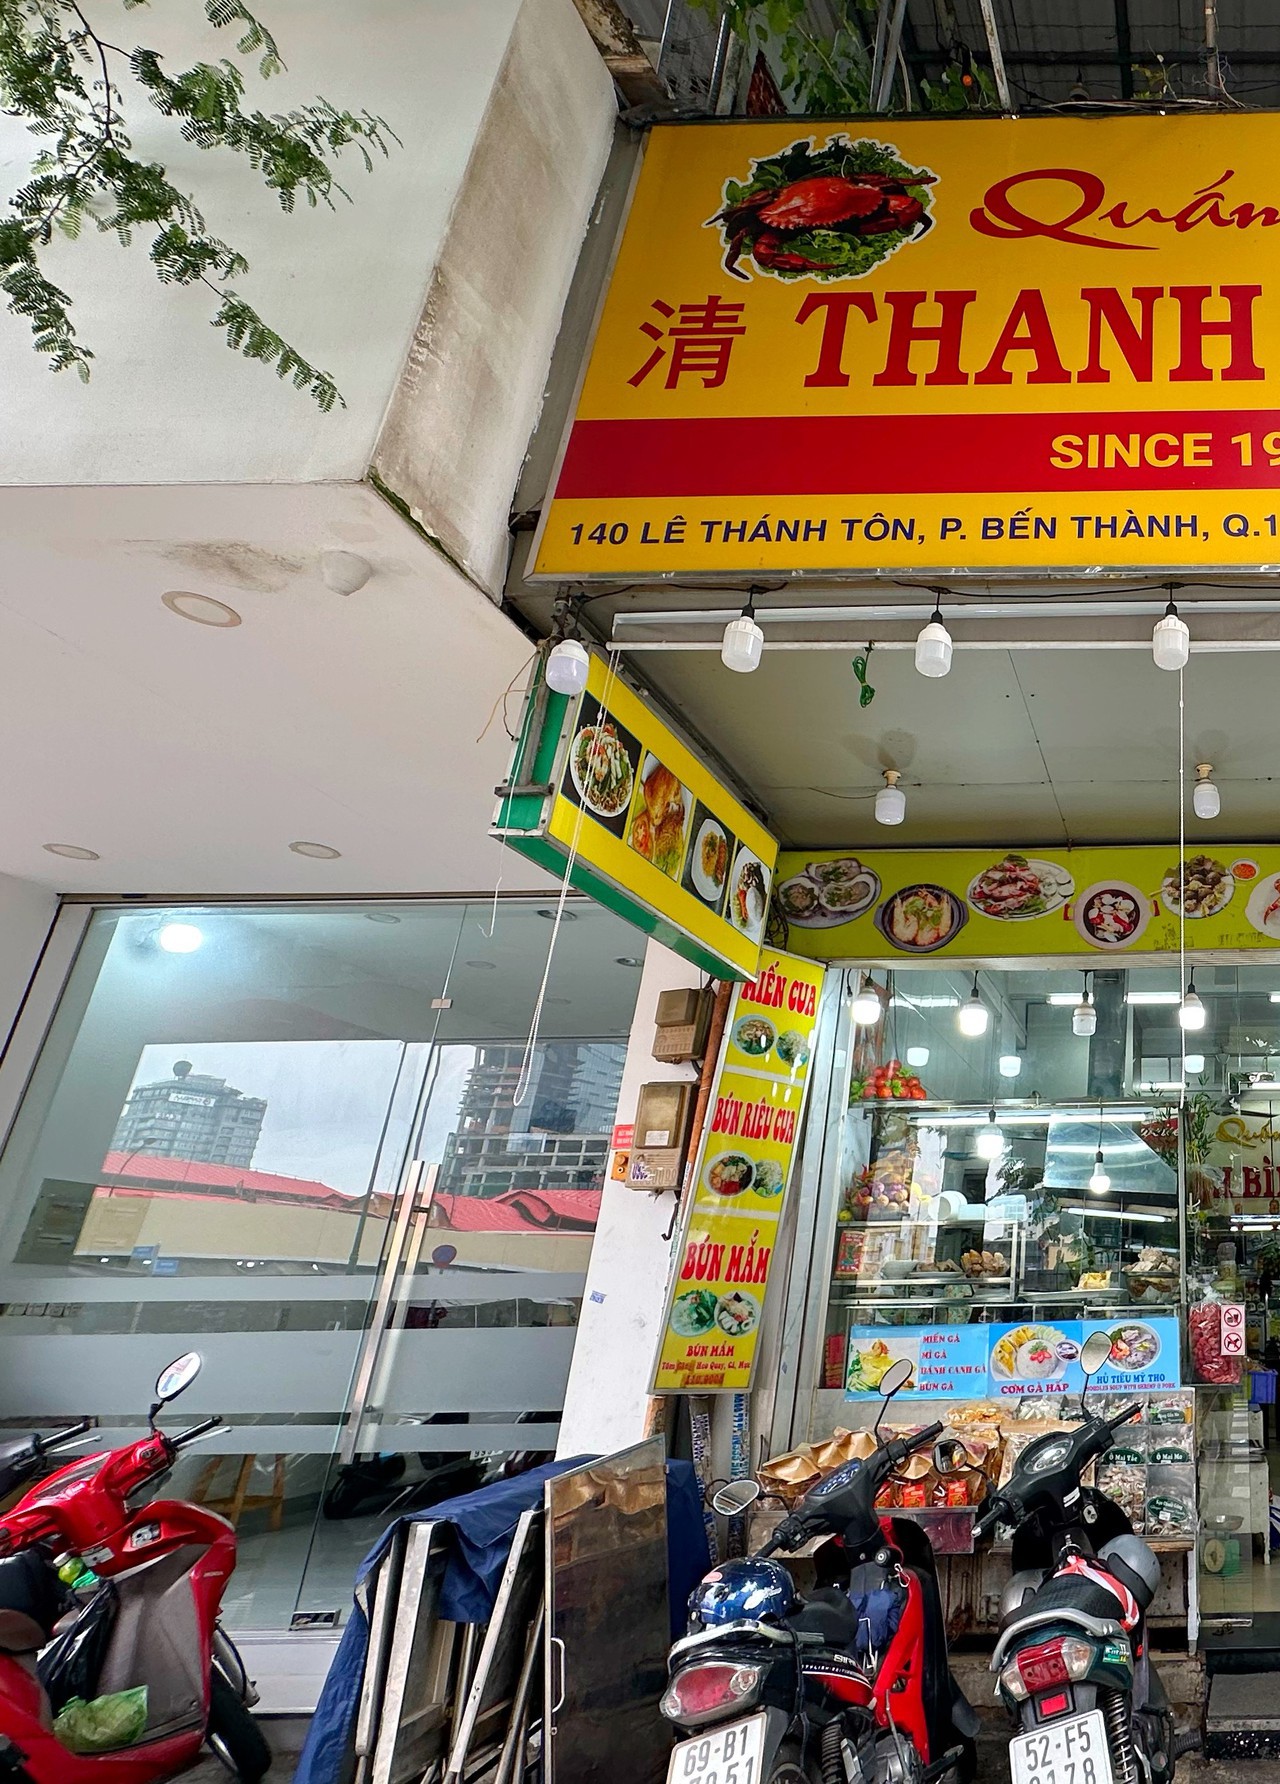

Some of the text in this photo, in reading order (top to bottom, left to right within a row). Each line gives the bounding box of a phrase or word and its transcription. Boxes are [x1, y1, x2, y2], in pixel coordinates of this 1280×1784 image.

[628, 296, 746, 390] 清
[794, 285, 1266, 388] THANH
[1050, 433, 1213, 469] SINCE
[570, 507, 1279, 546] 140 LÊ THÁNH TÔN, P. BẾN THÀNH, Q.1
[741, 961, 817, 1017] MIẾN CUA
[711, 1092, 796, 1144] BÚN RIÊU CUA
[681, 1229, 771, 1284] BÚN MẮM
[686, 1340, 735, 1357] BÚN MẮM
[921, 1349, 947, 1359] MÌ GÀ
[923, 1332, 960, 1343] MIẾN GÀ
[919, 1381, 954, 1391] BÚN GÀ
[975, 1364, 986, 1373] GÀ
[1097, 1371, 1166, 1384] HỦ TIẾU MỸ THO
[1001, 1380, 1070, 1394] CƠM GÀ HẤP
[1115, 1453, 1126, 1461] Mai
[684, 1725, 748, 1776] 69-B1
[1025, 1720, 1091, 1771] 52-F5
